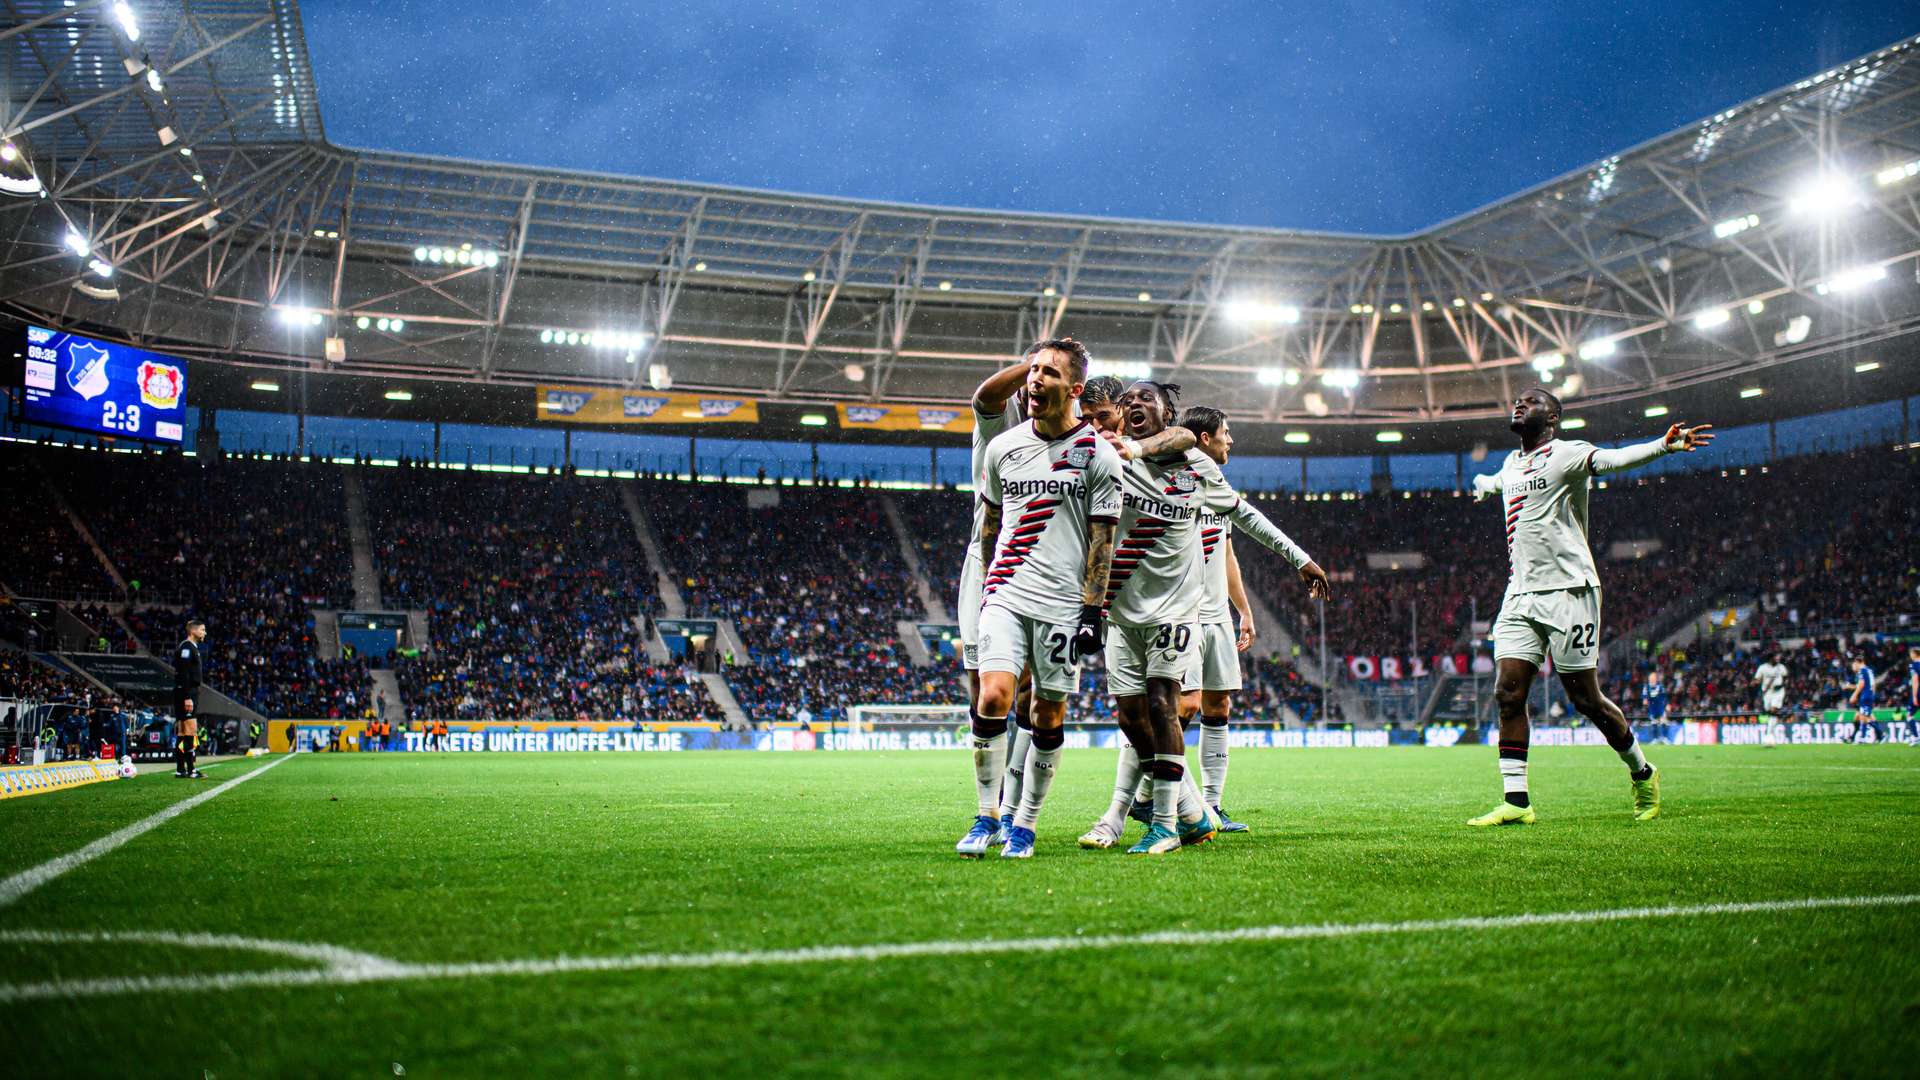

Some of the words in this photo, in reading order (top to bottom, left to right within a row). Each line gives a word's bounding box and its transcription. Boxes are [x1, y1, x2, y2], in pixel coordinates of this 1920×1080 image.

[547, 392, 583, 413] SAP
[625, 398, 661, 416] SAP
[701, 401, 736, 416] SAP
[103, 401, 140, 432] 2:3
[1102, 499, 1120, 510] triv
[1121, 491, 1195, 519] armenia
[1156, 623, 1191, 652] 30
[1572, 623, 1595, 648] 22
[1051, 633, 1079, 665] 20
[489, 732, 550, 752] UNTER
[553, 731, 683, 752] HOFFE-LIVE.DE
